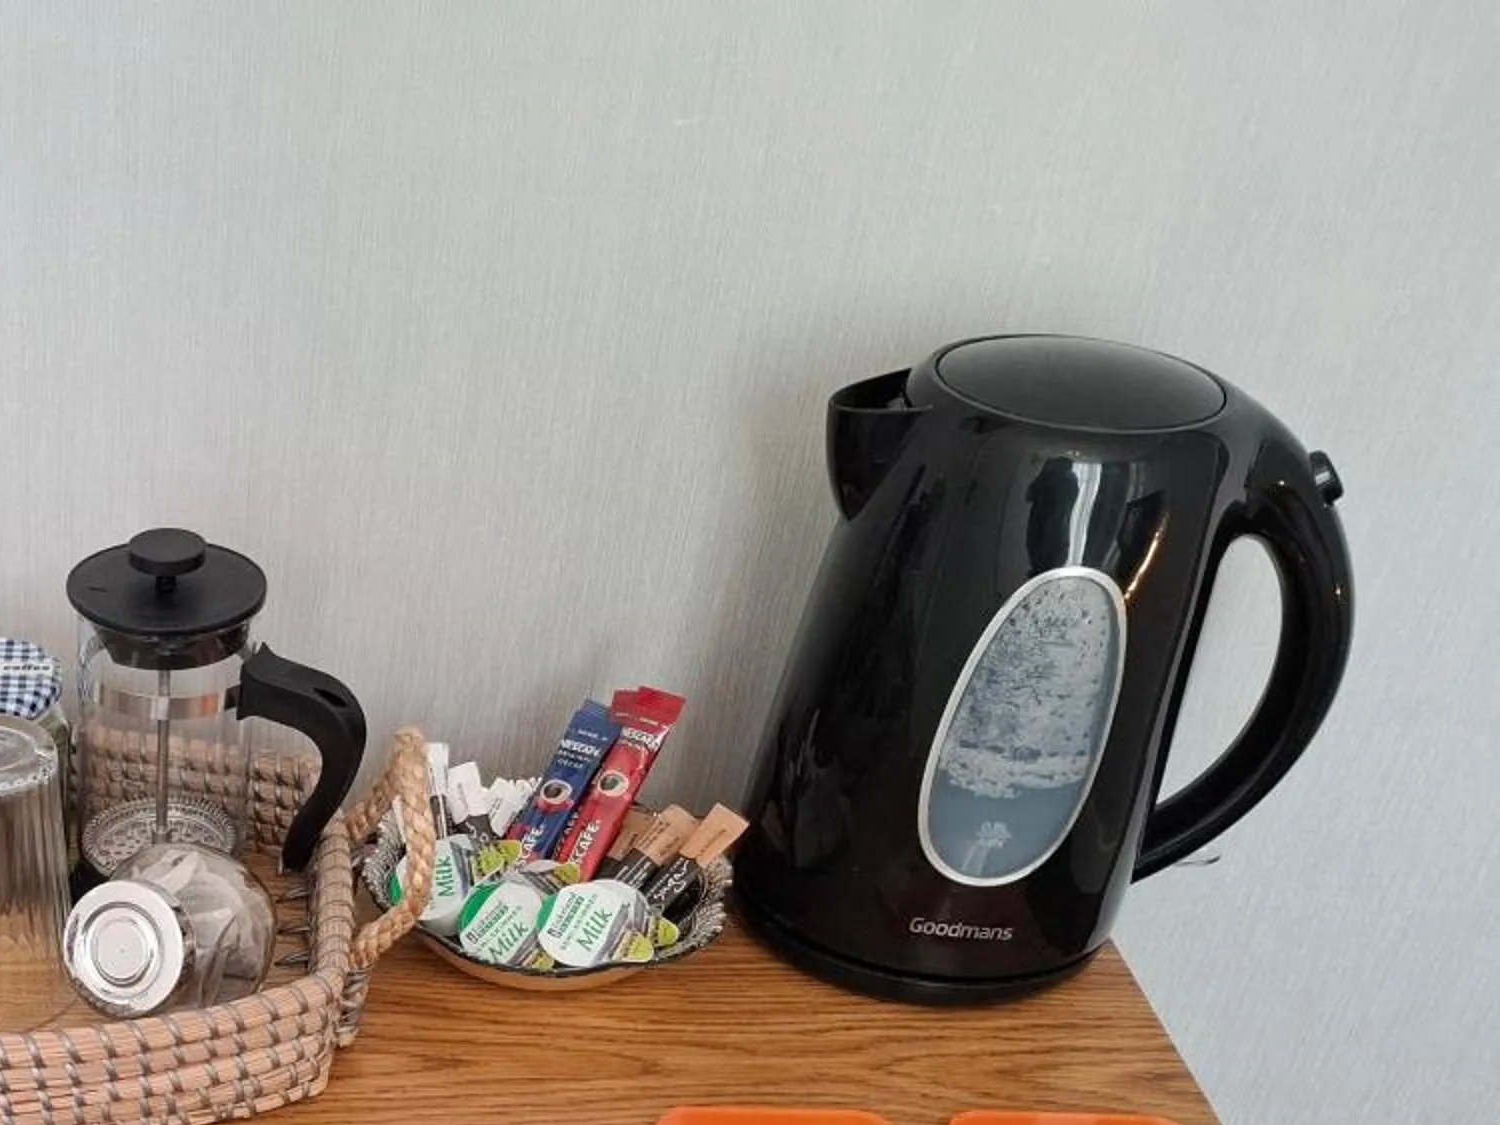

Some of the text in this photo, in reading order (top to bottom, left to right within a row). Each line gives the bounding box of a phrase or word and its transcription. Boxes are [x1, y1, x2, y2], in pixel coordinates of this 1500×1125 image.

[3, 661, 51, 671] coffee
[435, 855, 455, 897] Milk
[488, 922, 528, 961] Milk
[576, 908, 613, 953] Milk
[908, 916, 1014, 941] Goodmans
